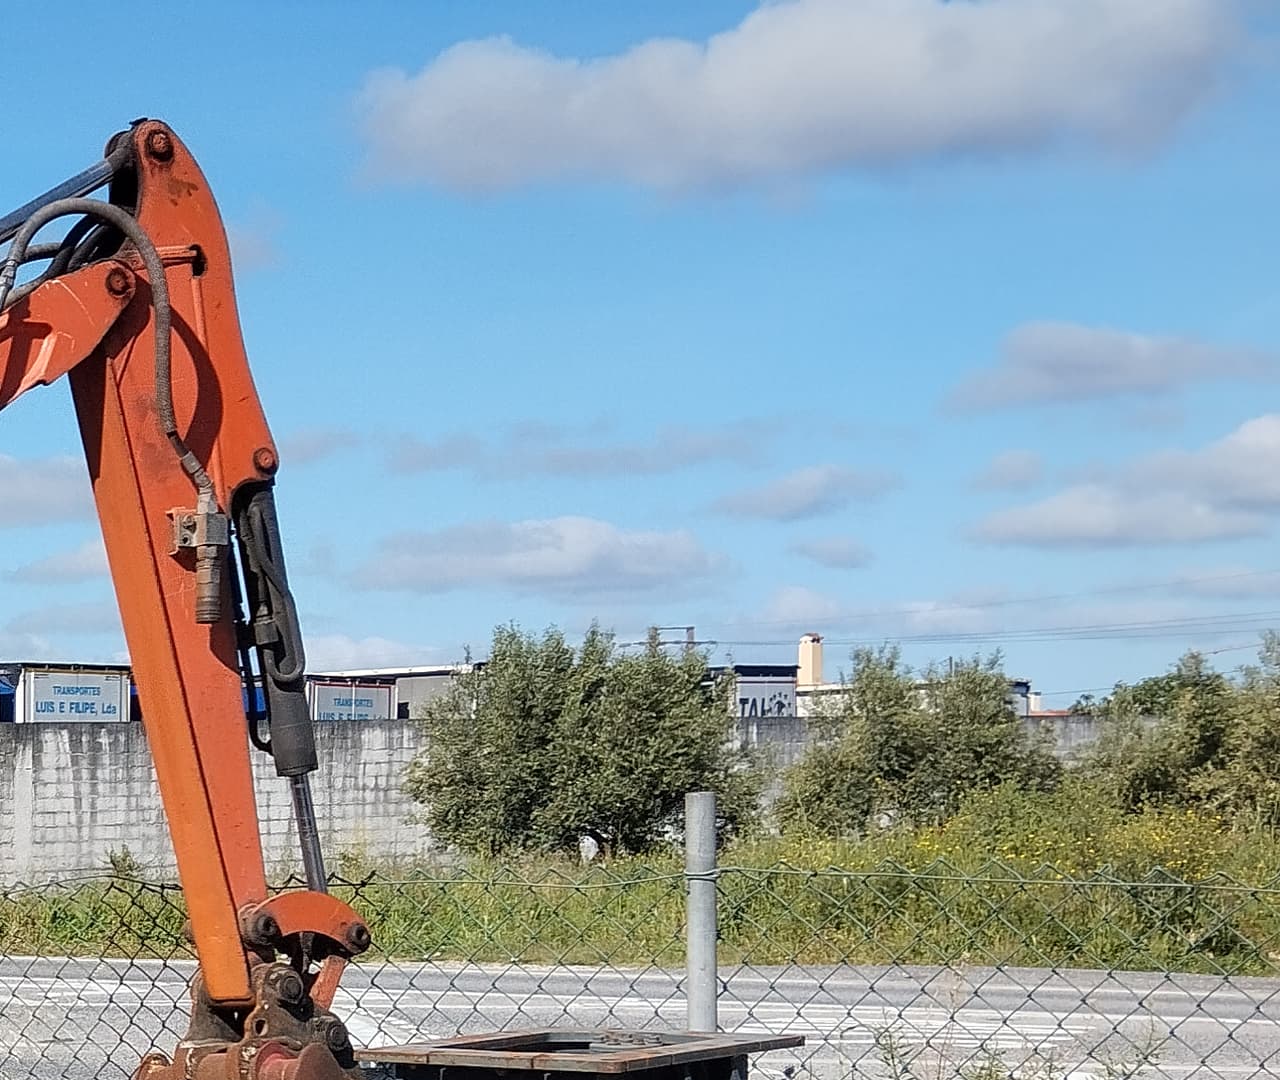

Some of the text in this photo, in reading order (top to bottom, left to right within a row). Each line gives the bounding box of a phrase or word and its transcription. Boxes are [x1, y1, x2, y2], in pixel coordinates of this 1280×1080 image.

[52, 685, 101, 696] TRANSPORTES
[35, 701, 55, 713] LUIS
[59, 702, 65, 713] E
[102, 702, 117, 714] Lda
